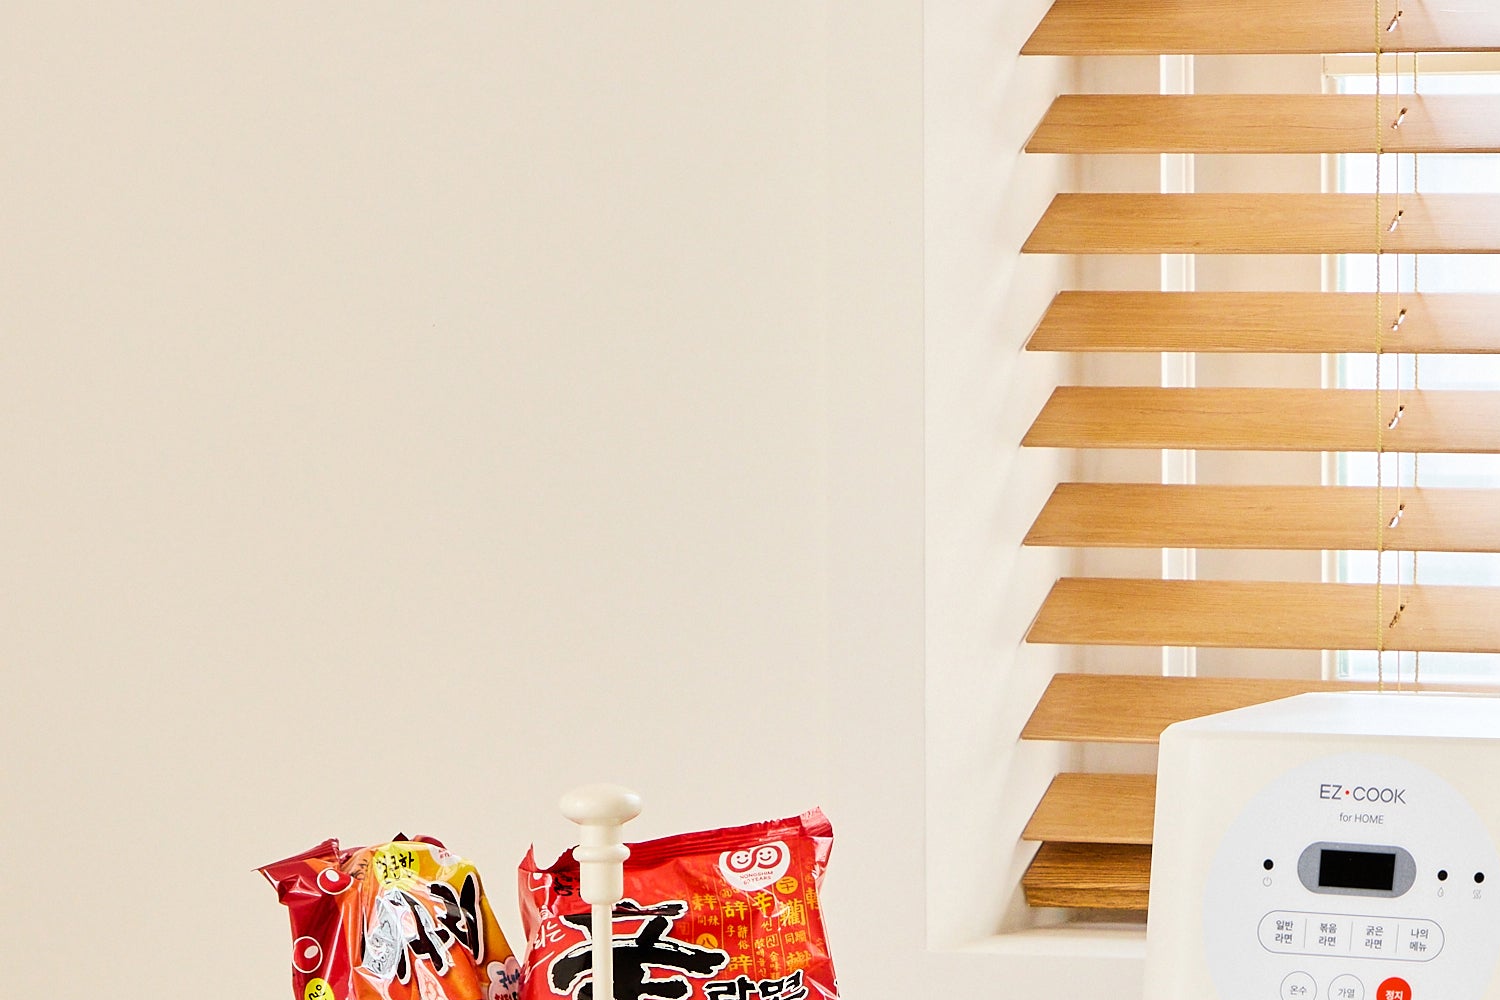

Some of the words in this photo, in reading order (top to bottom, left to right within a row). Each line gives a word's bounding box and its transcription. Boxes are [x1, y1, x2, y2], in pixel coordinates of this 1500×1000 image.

[1339, 812, 1352, 823] for
[1354, 813, 1385, 825] HOME
[751, 875, 772, 885] YEARS
[1275, 920, 1294, 932] 일반
[1319, 922, 1338, 935] 볶음
[1365, 925, 1384, 937] 굵은
[1275, 933, 1293, 945] 라면
[1410, 928, 1429, 940] 나의
[1318, 935, 1336, 947] 라면
[1364, 938, 1383, 950] 라면
[1409, 941, 1428, 952] 메뉴
[1289, 985, 1307, 997] 온수
[1337, 987, 1356, 999] 가열
